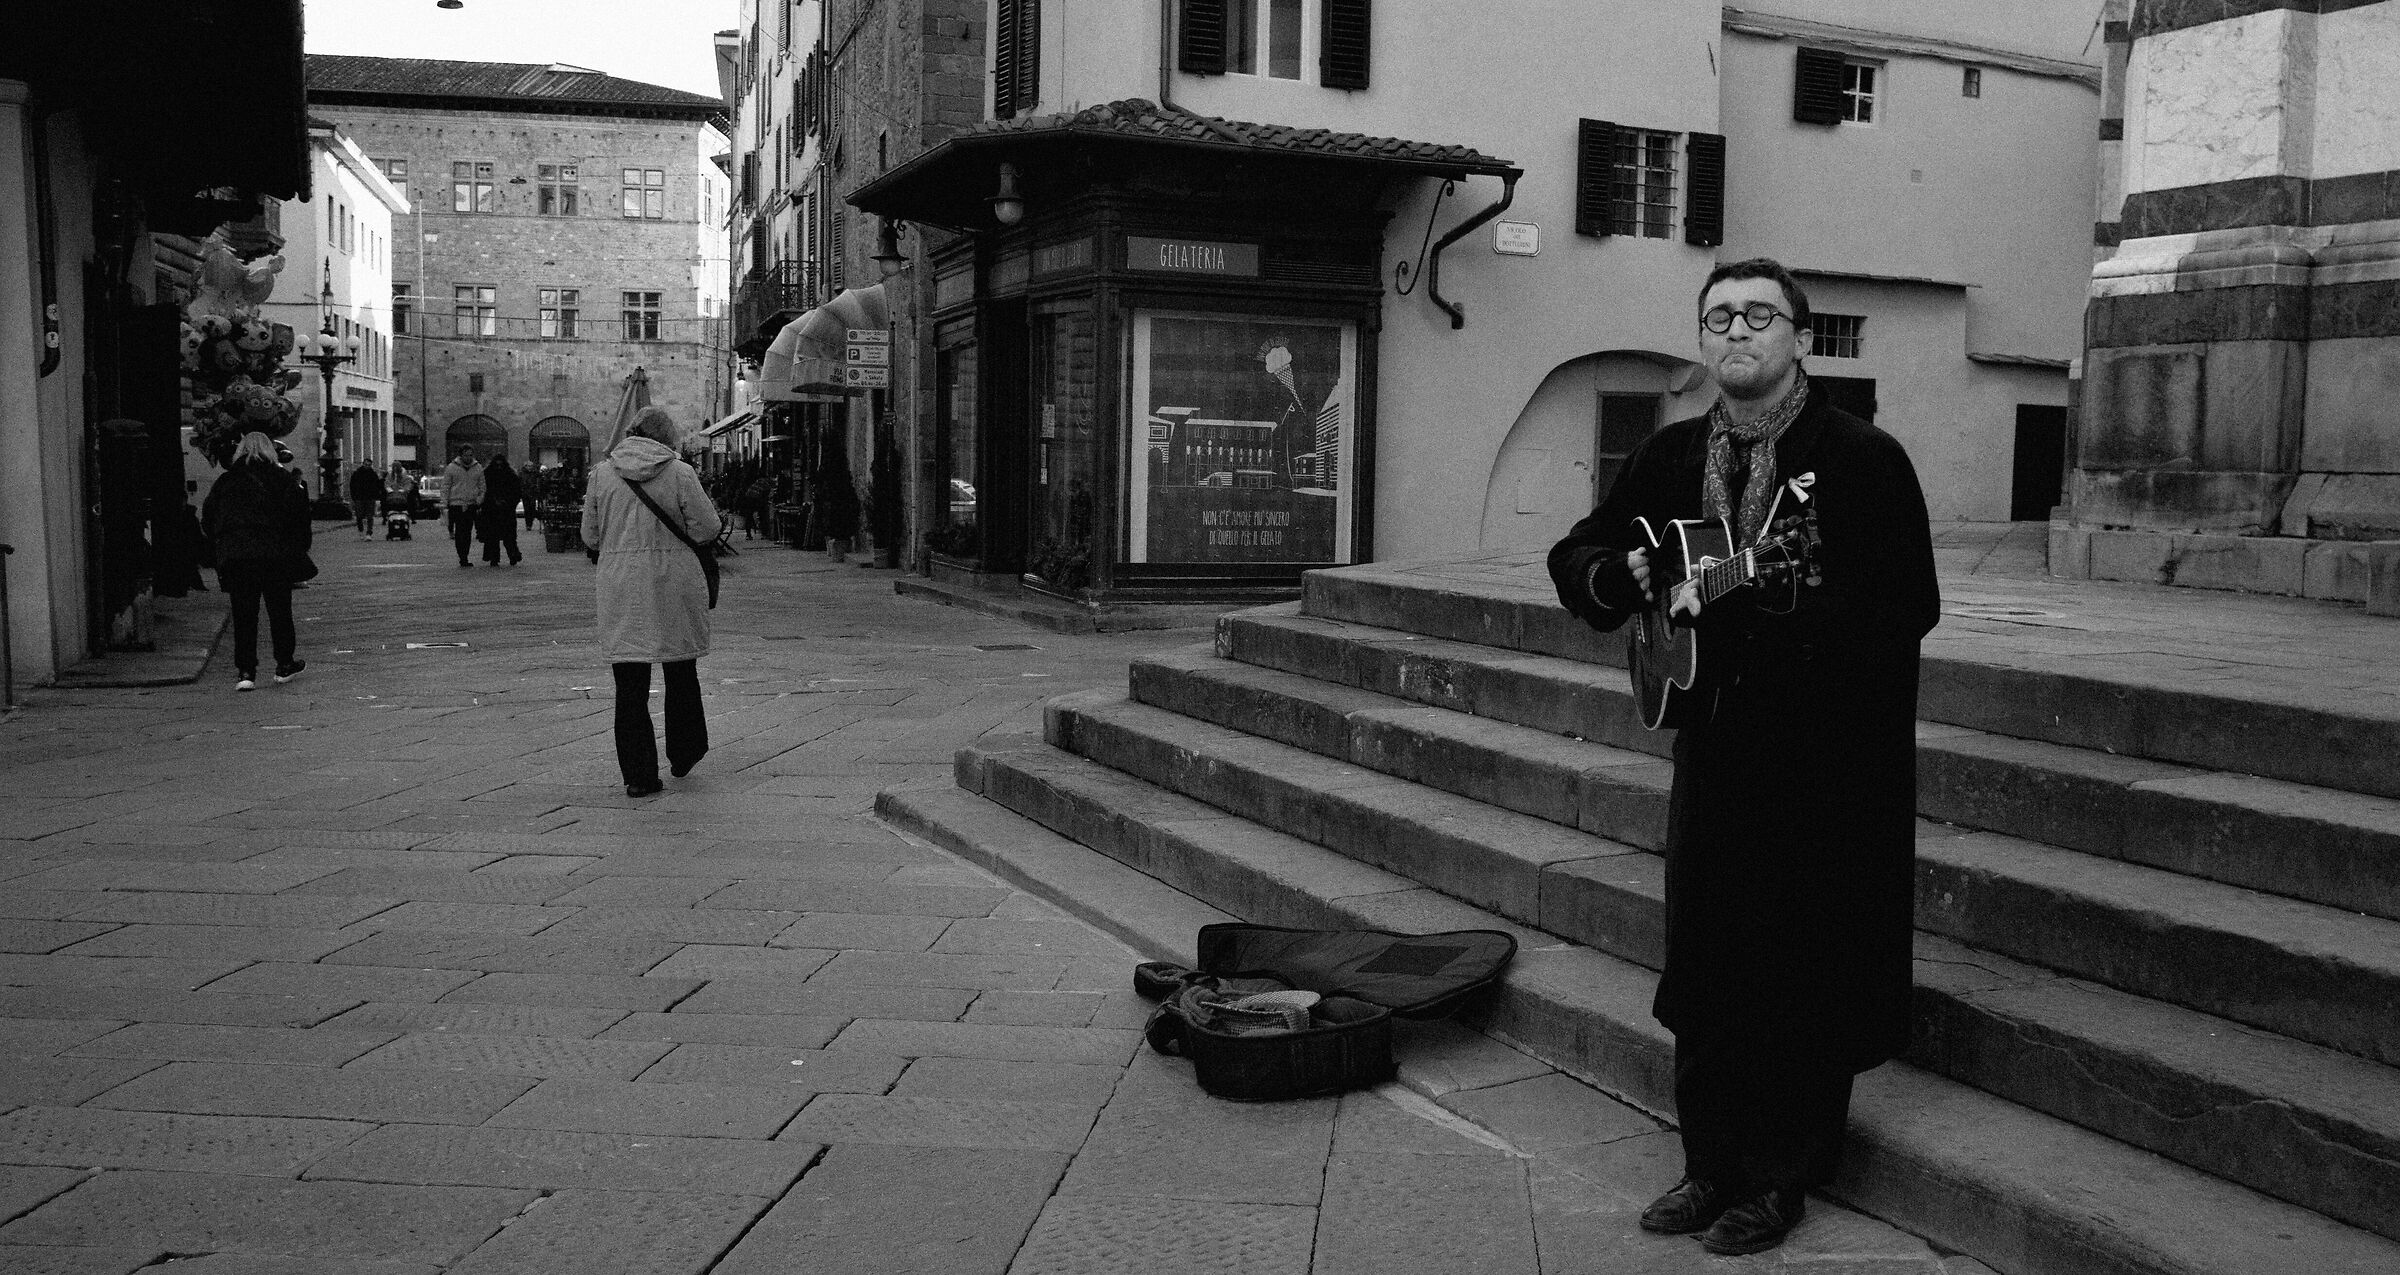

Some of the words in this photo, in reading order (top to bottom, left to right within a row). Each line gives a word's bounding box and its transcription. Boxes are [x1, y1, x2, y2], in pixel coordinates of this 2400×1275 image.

[1160, 244, 1225, 270] GELATERIA
[1203, 510, 1217, 526] NON
[1266, 510, 1290, 527] SINCERO
[1260, 530, 1282, 546] GELATO
